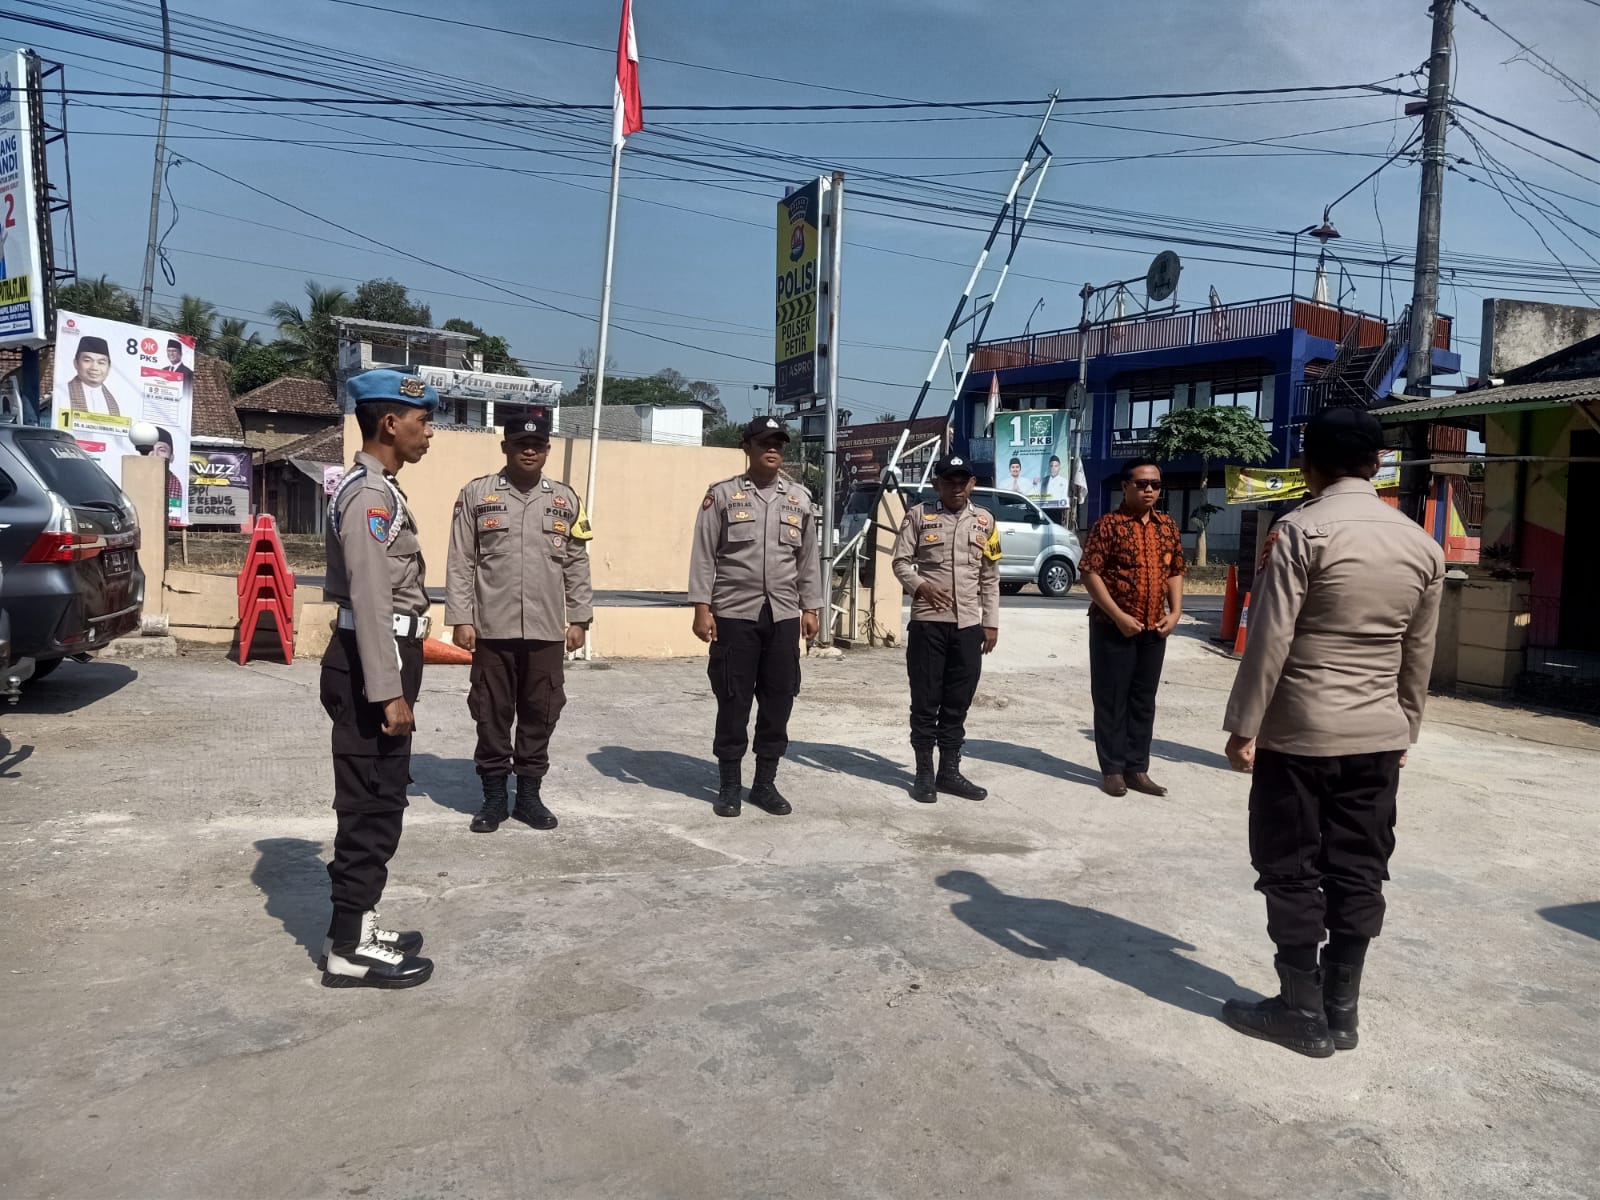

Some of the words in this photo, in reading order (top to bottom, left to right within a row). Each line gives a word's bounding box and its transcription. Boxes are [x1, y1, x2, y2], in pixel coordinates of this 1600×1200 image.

[4, 193, 16, 229] 2
[777, 258, 816, 304] POLISI
[781, 316, 811, 343] POLSEK
[126, 338, 138, 355] 8
[140, 353, 158, 364] PKS
[784, 335, 807, 357] PETIR
[789, 359, 813, 377] ASPRO
[61, 411, 70, 428] 1
[1009, 415, 1025, 447] 1
[1029, 436, 1052, 445] PKB
[1269, 478, 1279, 489] 2
[195, 505, 236, 516] GORENG
[546, 507, 571, 520] POLRI
